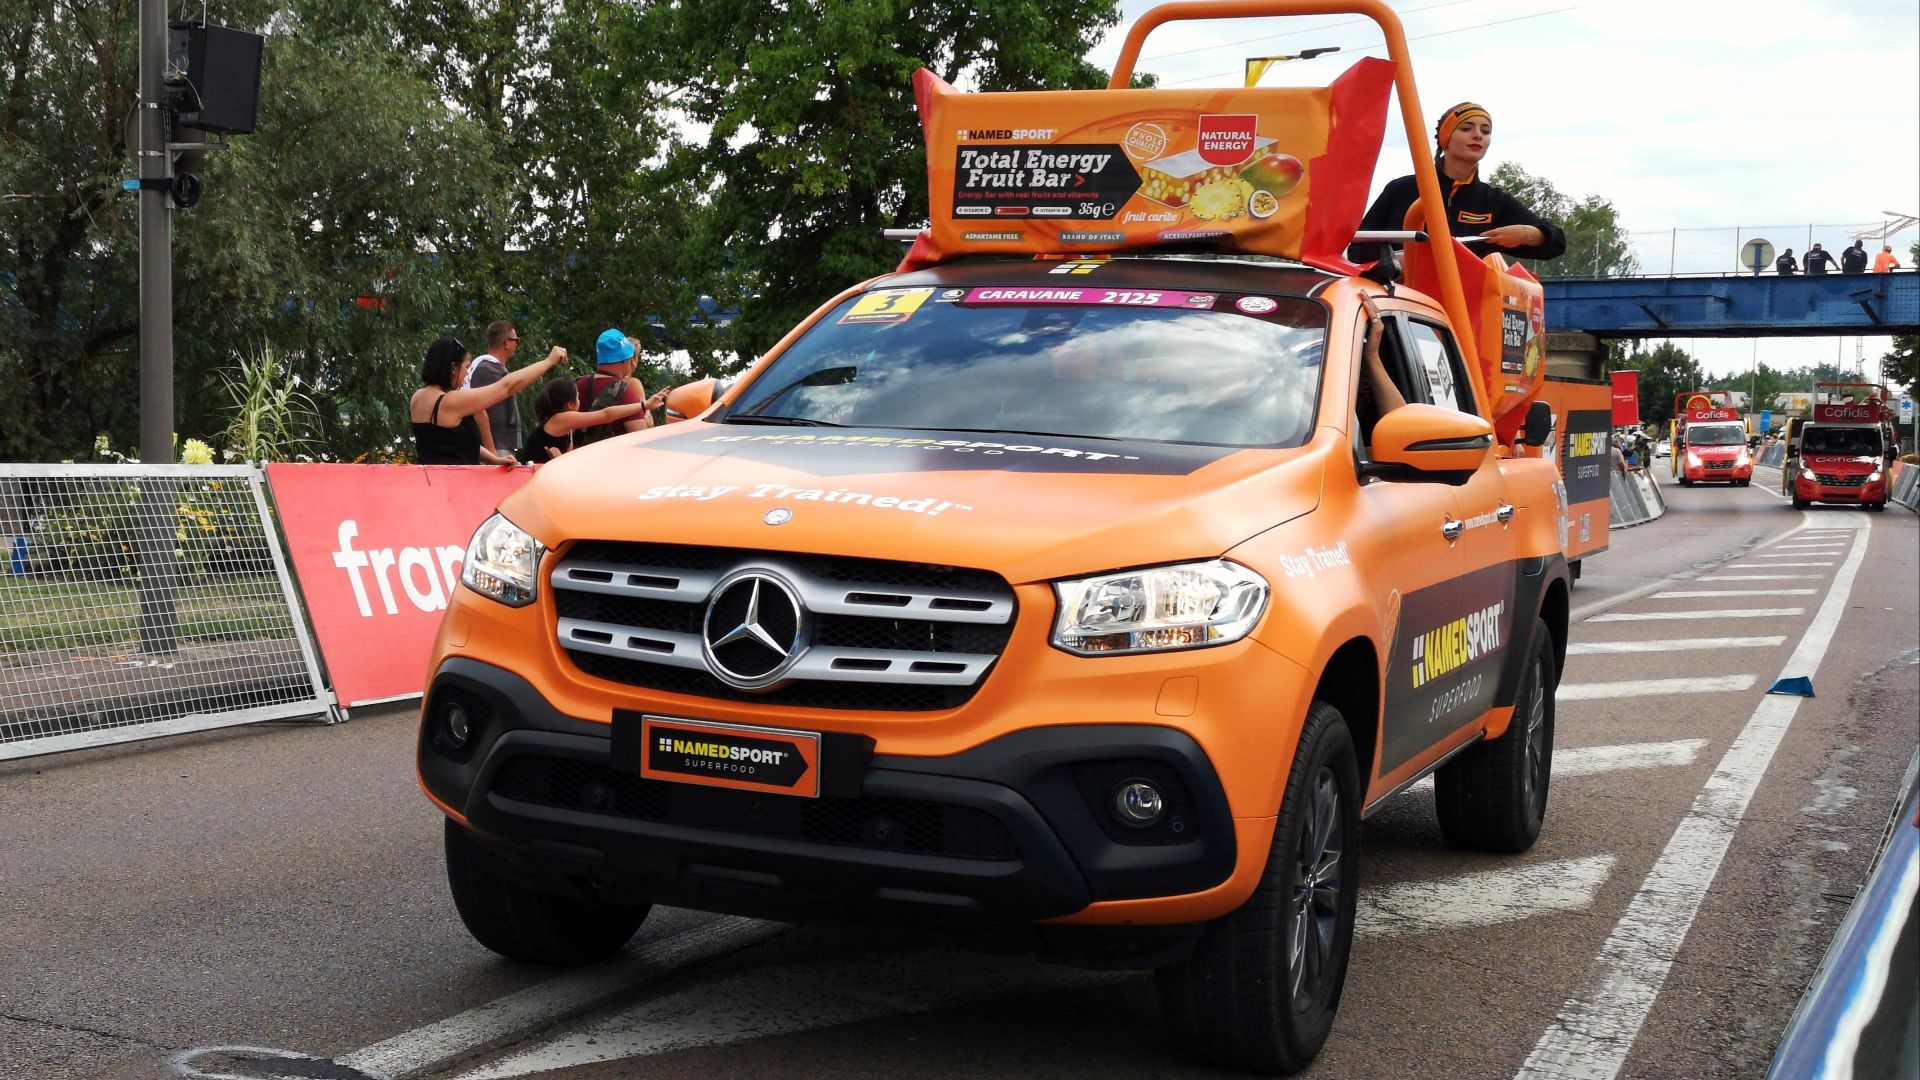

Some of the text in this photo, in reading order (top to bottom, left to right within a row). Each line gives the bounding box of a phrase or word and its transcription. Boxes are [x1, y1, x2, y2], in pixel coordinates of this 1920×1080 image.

[1129, 136, 1161, 153] QUALITY
[1132, 128, 1163, 146] WHOLE
[1201, 131, 1253, 141] NATURAL
[1203, 141, 1249, 150] ENERGY
[961, 149, 1112, 174] Total Energy
[965, 168, 1072, 188] Fruit Bar
[958, 191, 984, 200] Energy
[984, 191, 998, 199] Bar
[999, 191, 1015, 199] with
[1015, 191, 1030, 199] real
[1052, 191, 1067, 199] and
[1068, 191, 1100, 199] vitamins
[1078, 202, 1101, 219] 35g
[1122, 211, 1178, 225] fruit caribe
[964, 233, 1003, 241] ASPARTAME
[1062, 233, 1121, 241] BRAND OF ITALY
[874, 294, 905, 312] 3
[978, 290, 1163, 305] CARAVANE 2125
[1695, 410, 1730, 420] Cofidis
[1824, 406, 1871, 418] Cofidis
[637, 483, 741, 502] Stay
[1279, 553, 1315, 579] Stay
[1428, 673, 1483, 724] SUPERFOOD
[684, 757, 756, 774] SUPERFOOD
